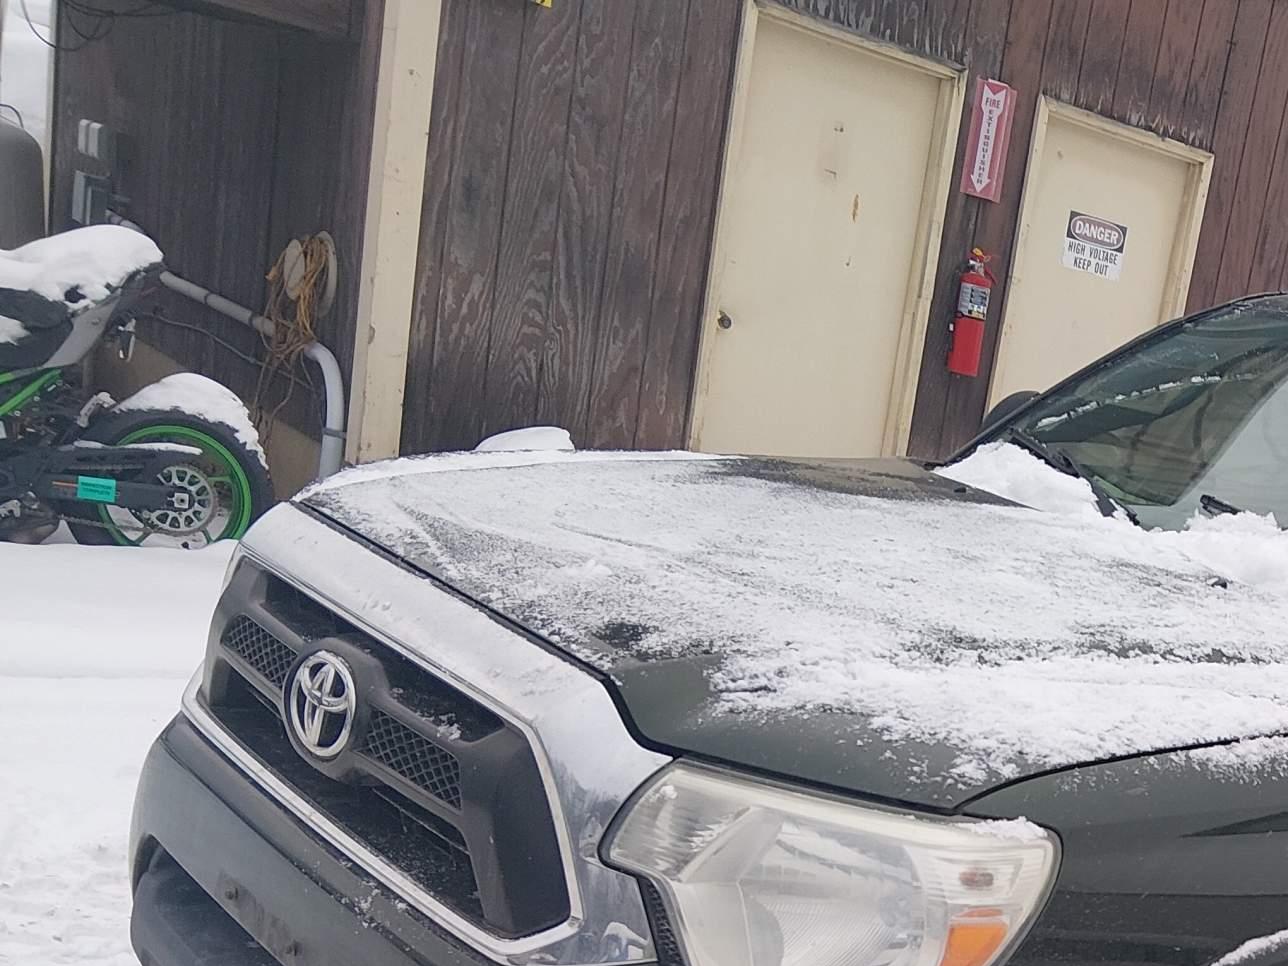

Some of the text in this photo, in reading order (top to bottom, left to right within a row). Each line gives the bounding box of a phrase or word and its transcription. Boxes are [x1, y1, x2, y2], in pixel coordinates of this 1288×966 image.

[985, 97, 1001, 109] FIRE
[976, 109, 993, 185] EXTINGUISHER
[1075, 220, 1119, 245] DANGER
[1068, 240, 1119, 265] HIGH VOLTAGE
[1073, 256, 1109, 276] KEEP OUT
